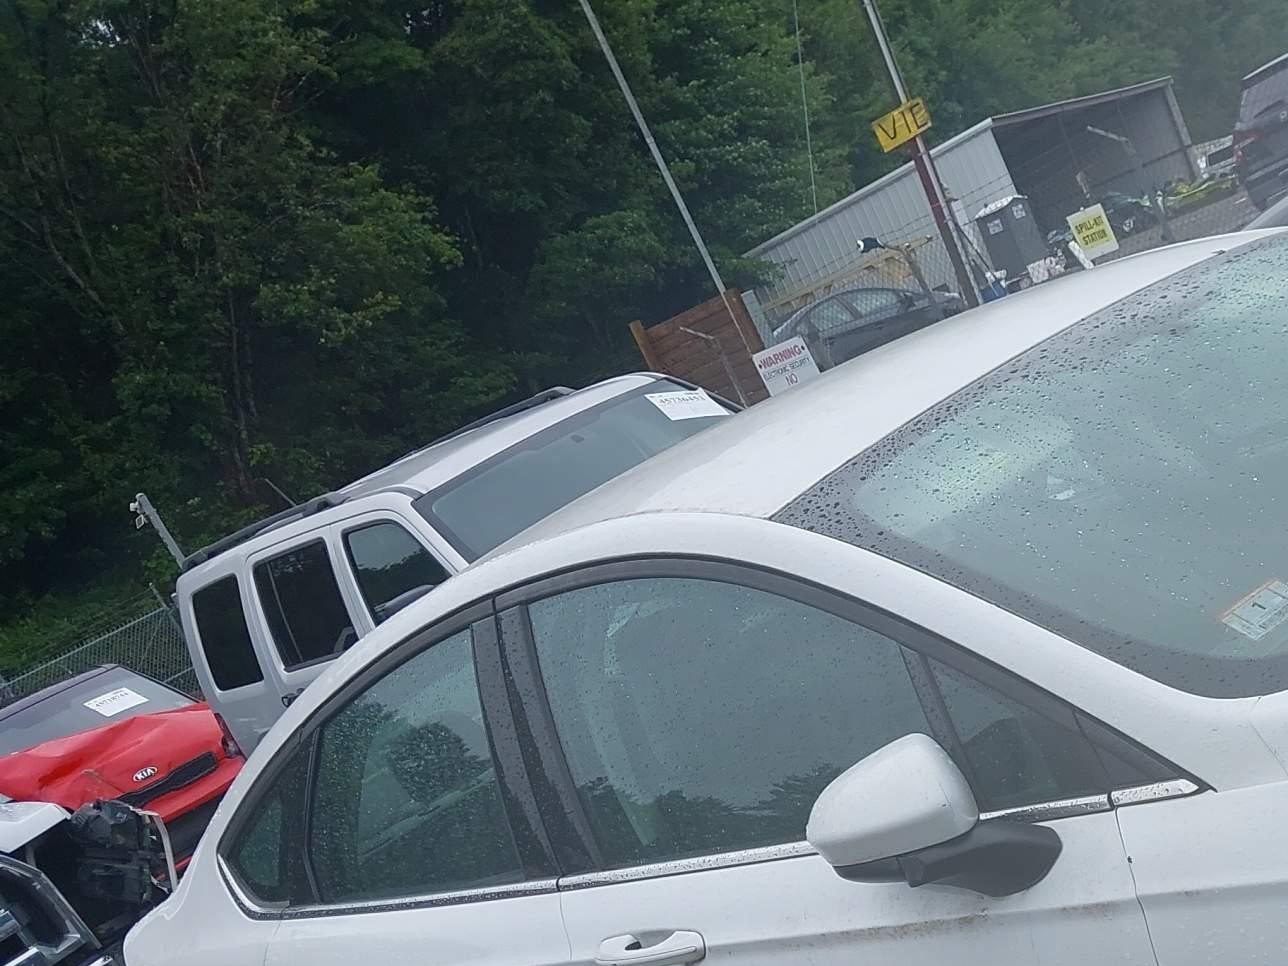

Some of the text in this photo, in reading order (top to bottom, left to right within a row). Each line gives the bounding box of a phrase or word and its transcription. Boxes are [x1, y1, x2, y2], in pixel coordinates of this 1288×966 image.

[1082, 229, 1108, 246] STATION
[760, 344, 802, 369] WARNING
[785, 373, 798, 386] NO
[135, 768, 156, 780] KIA
